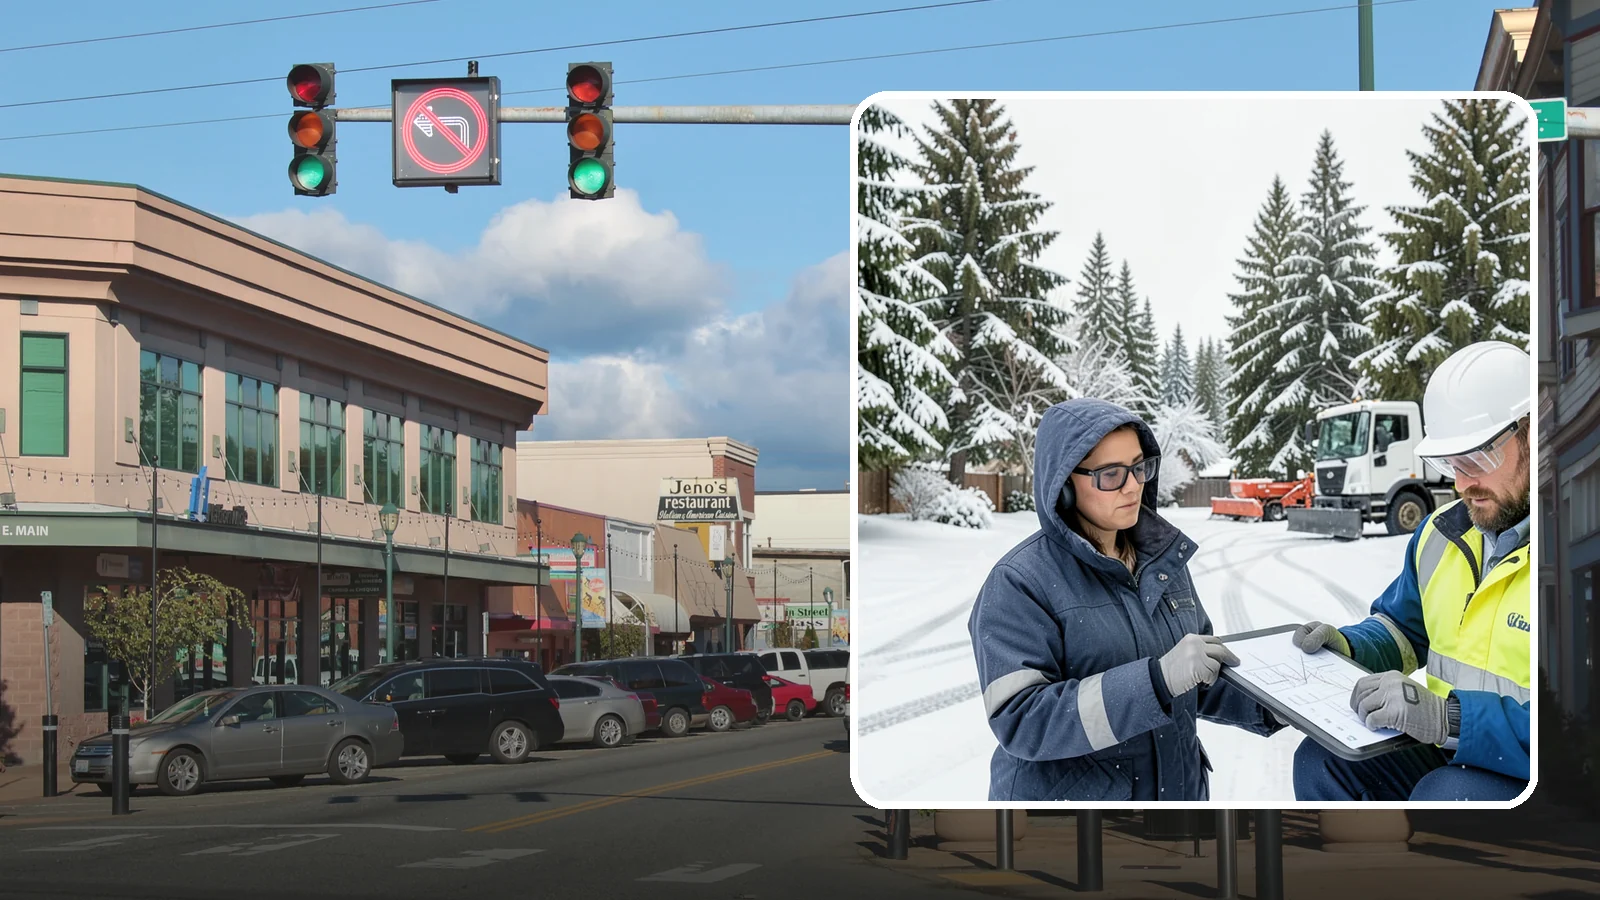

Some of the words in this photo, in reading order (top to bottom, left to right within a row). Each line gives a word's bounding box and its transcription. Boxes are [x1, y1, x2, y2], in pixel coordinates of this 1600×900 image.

[670, 480, 727, 494] Jeno's
[665, 497, 731, 509] restaurant
[715, 510, 738, 519] Cuisine
[2, 525, 13, 536] E.
[15, 525, 49, 536] MAIN
[797, 608, 828, 617] Street
